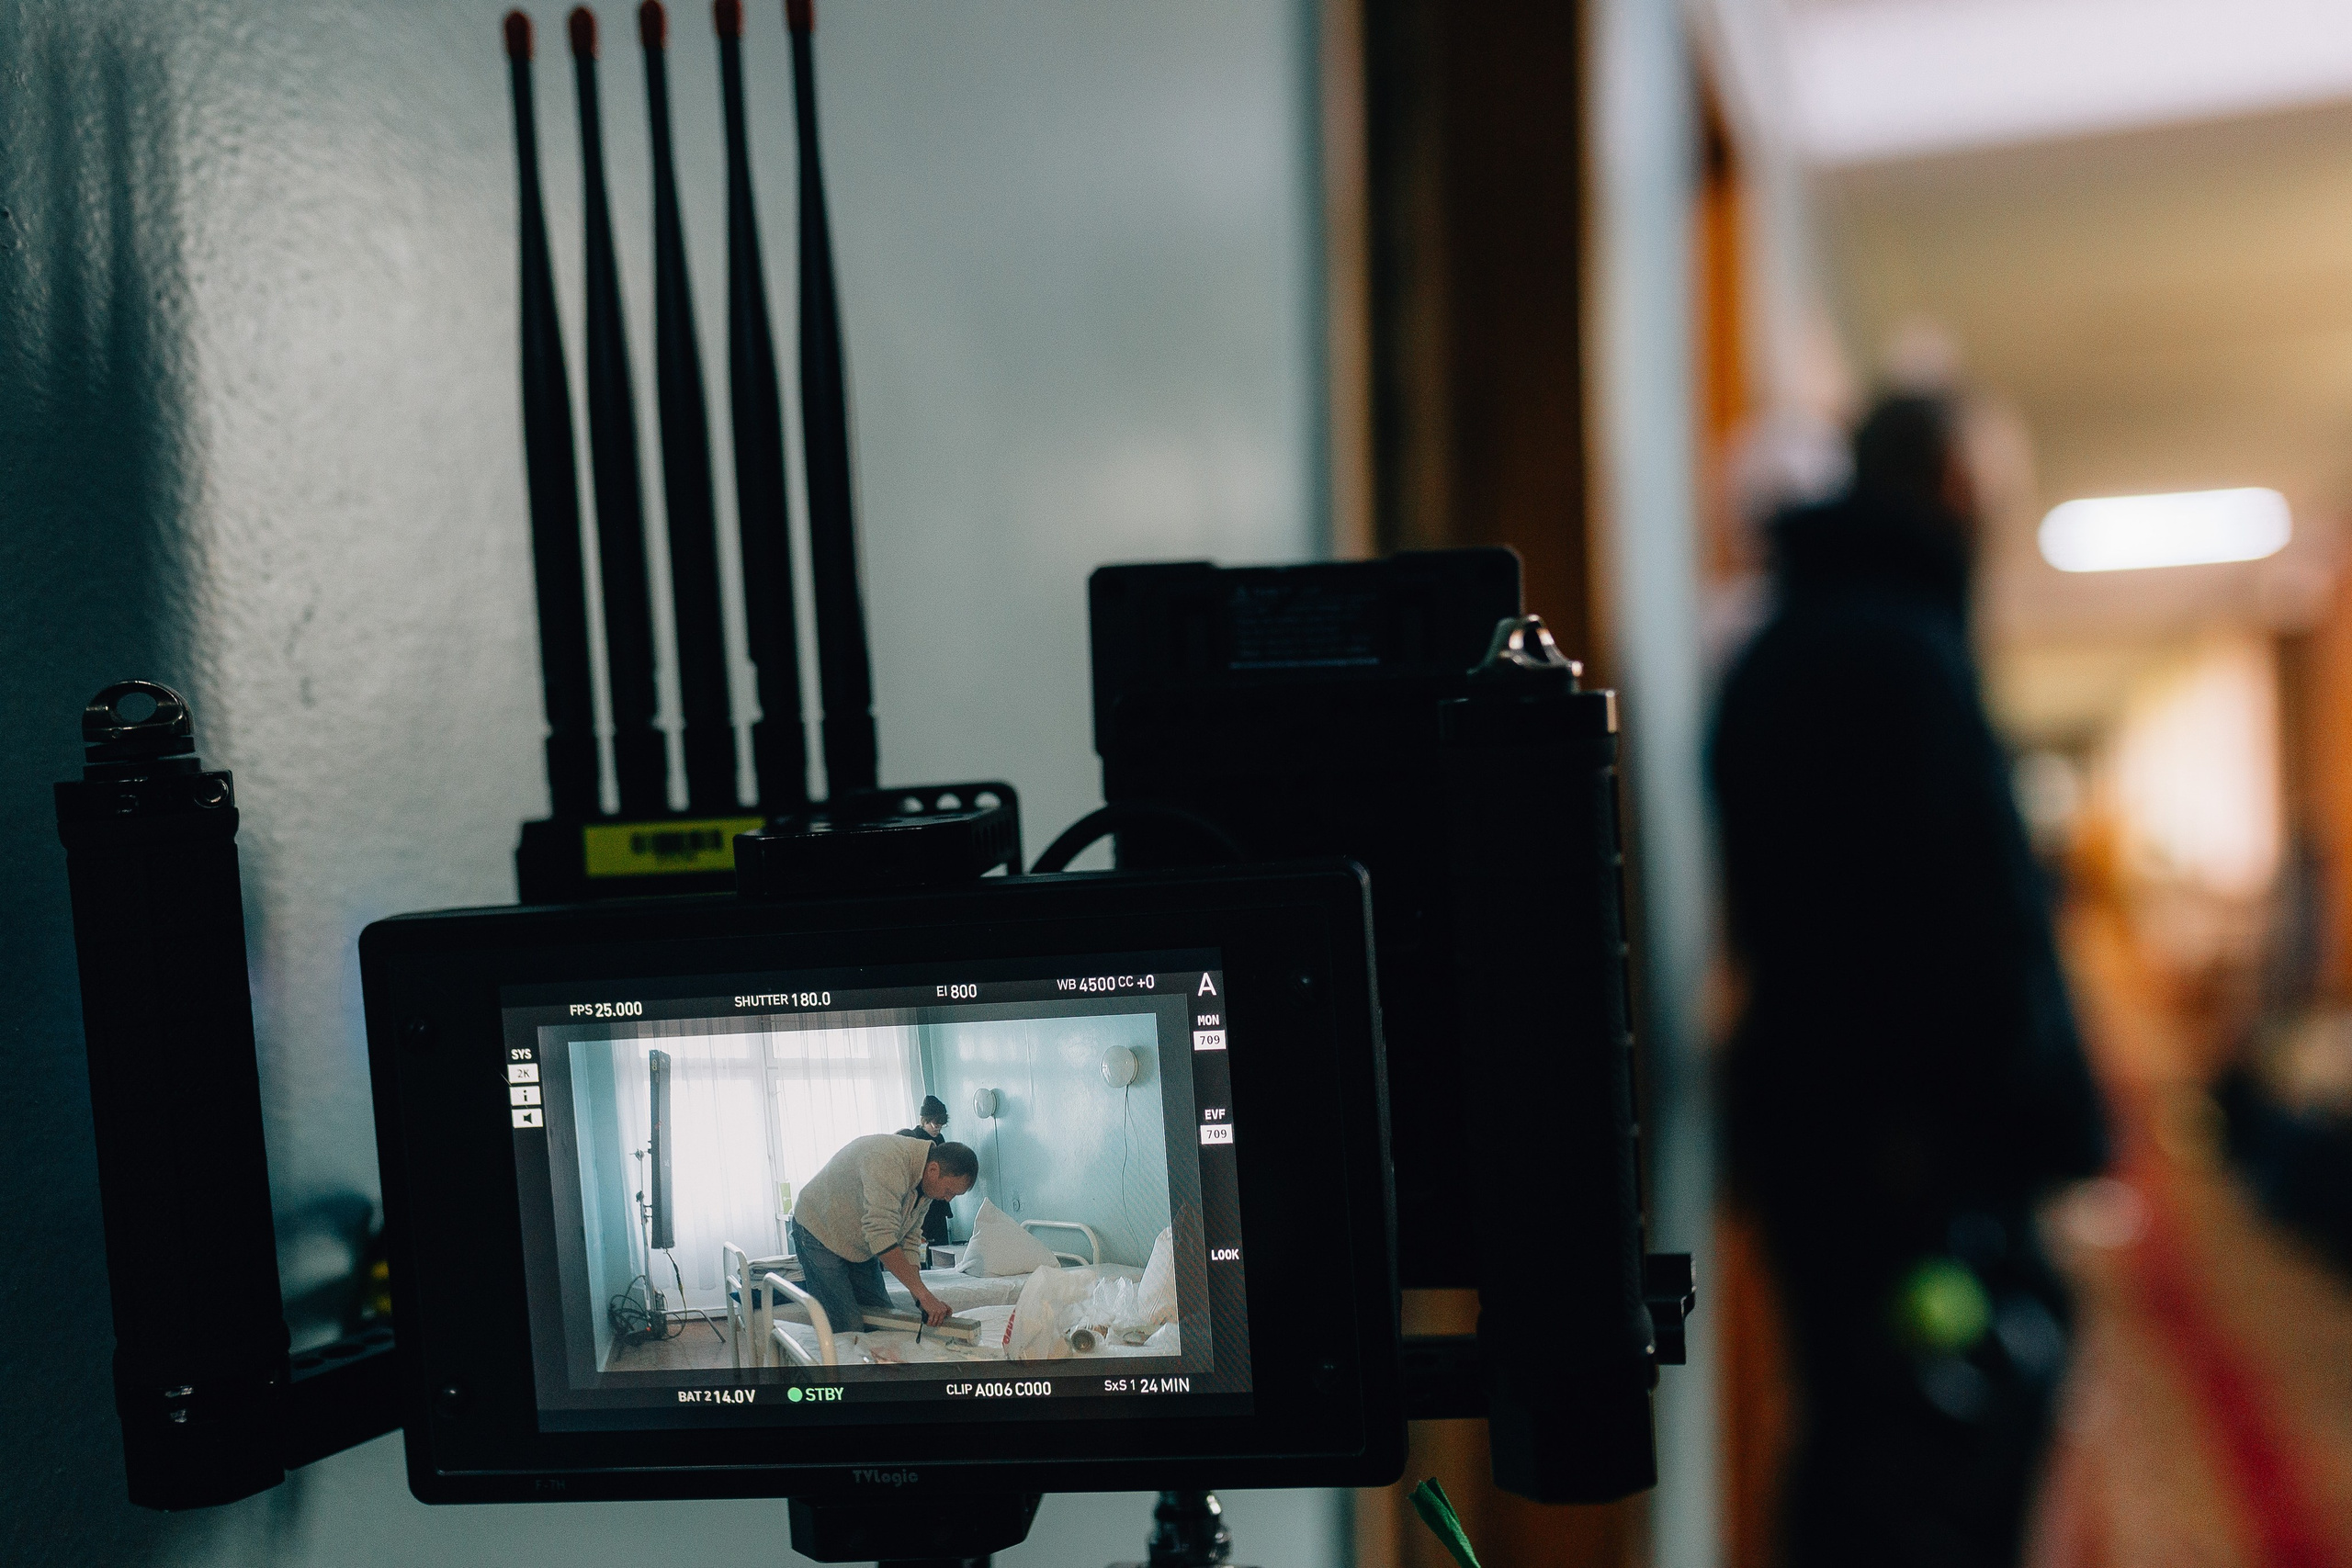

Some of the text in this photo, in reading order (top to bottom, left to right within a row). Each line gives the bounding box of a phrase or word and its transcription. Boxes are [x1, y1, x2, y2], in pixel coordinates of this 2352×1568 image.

[1056, 974, 1155, 992] WB 4500 CC +0
[1197, 972, 1217, 997] A
[936, 983, 978, 999] EI 800
[734, 991, 831, 1008] SHUTTER 180.0
[570, 1000, 643, 1018] FPS 25.000
[1197, 1014, 1220, 1027] MON
[1199, 1034, 1220, 1045] 709
[511, 1048, 532, 1060] SYS
[517, 1068, 530, 1078] 2K
[1204, 1108, 1226, 1121] EVF
[1206, 1129, 1227, 1139] 709
[1211, 1248, 1240, 1261] LOOK
[945, 1381, 1052, 1397] CLIP A006 C000
[1103, 1377, 1190, 1393] SxS 1 24 MIN
[677, 1390, 703, 1403] BAT
[713, 1389, 756, 1404] 14.0V
[805, 1387, 844, 1402] STBY
